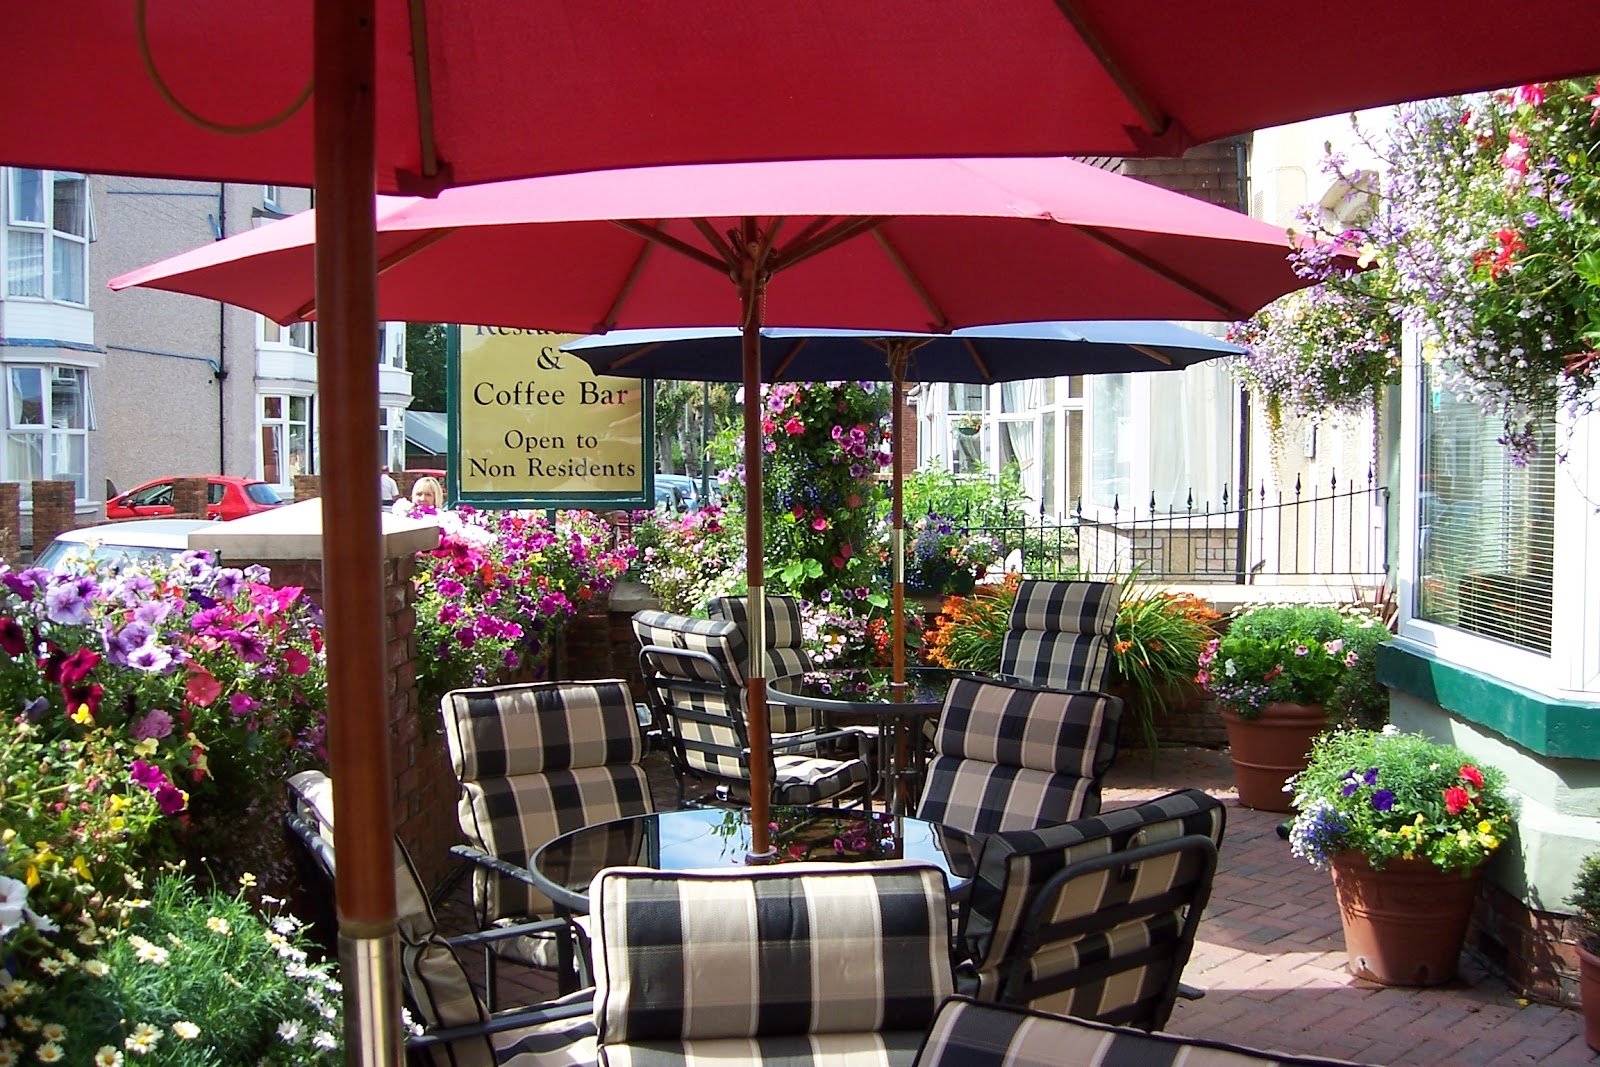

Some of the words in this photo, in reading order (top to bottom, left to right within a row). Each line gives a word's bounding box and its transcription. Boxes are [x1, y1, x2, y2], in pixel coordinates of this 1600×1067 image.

[537, 347, 564, 370] &
[473, 381, 565, 405] Coffee
[578, 381, 628, 405] Bar
[504, 429, 565, 452] Open
[576, 434, 598, 449] to
[468, 457, 516, 477] Non
[527, 457, 635, 477] Residents
